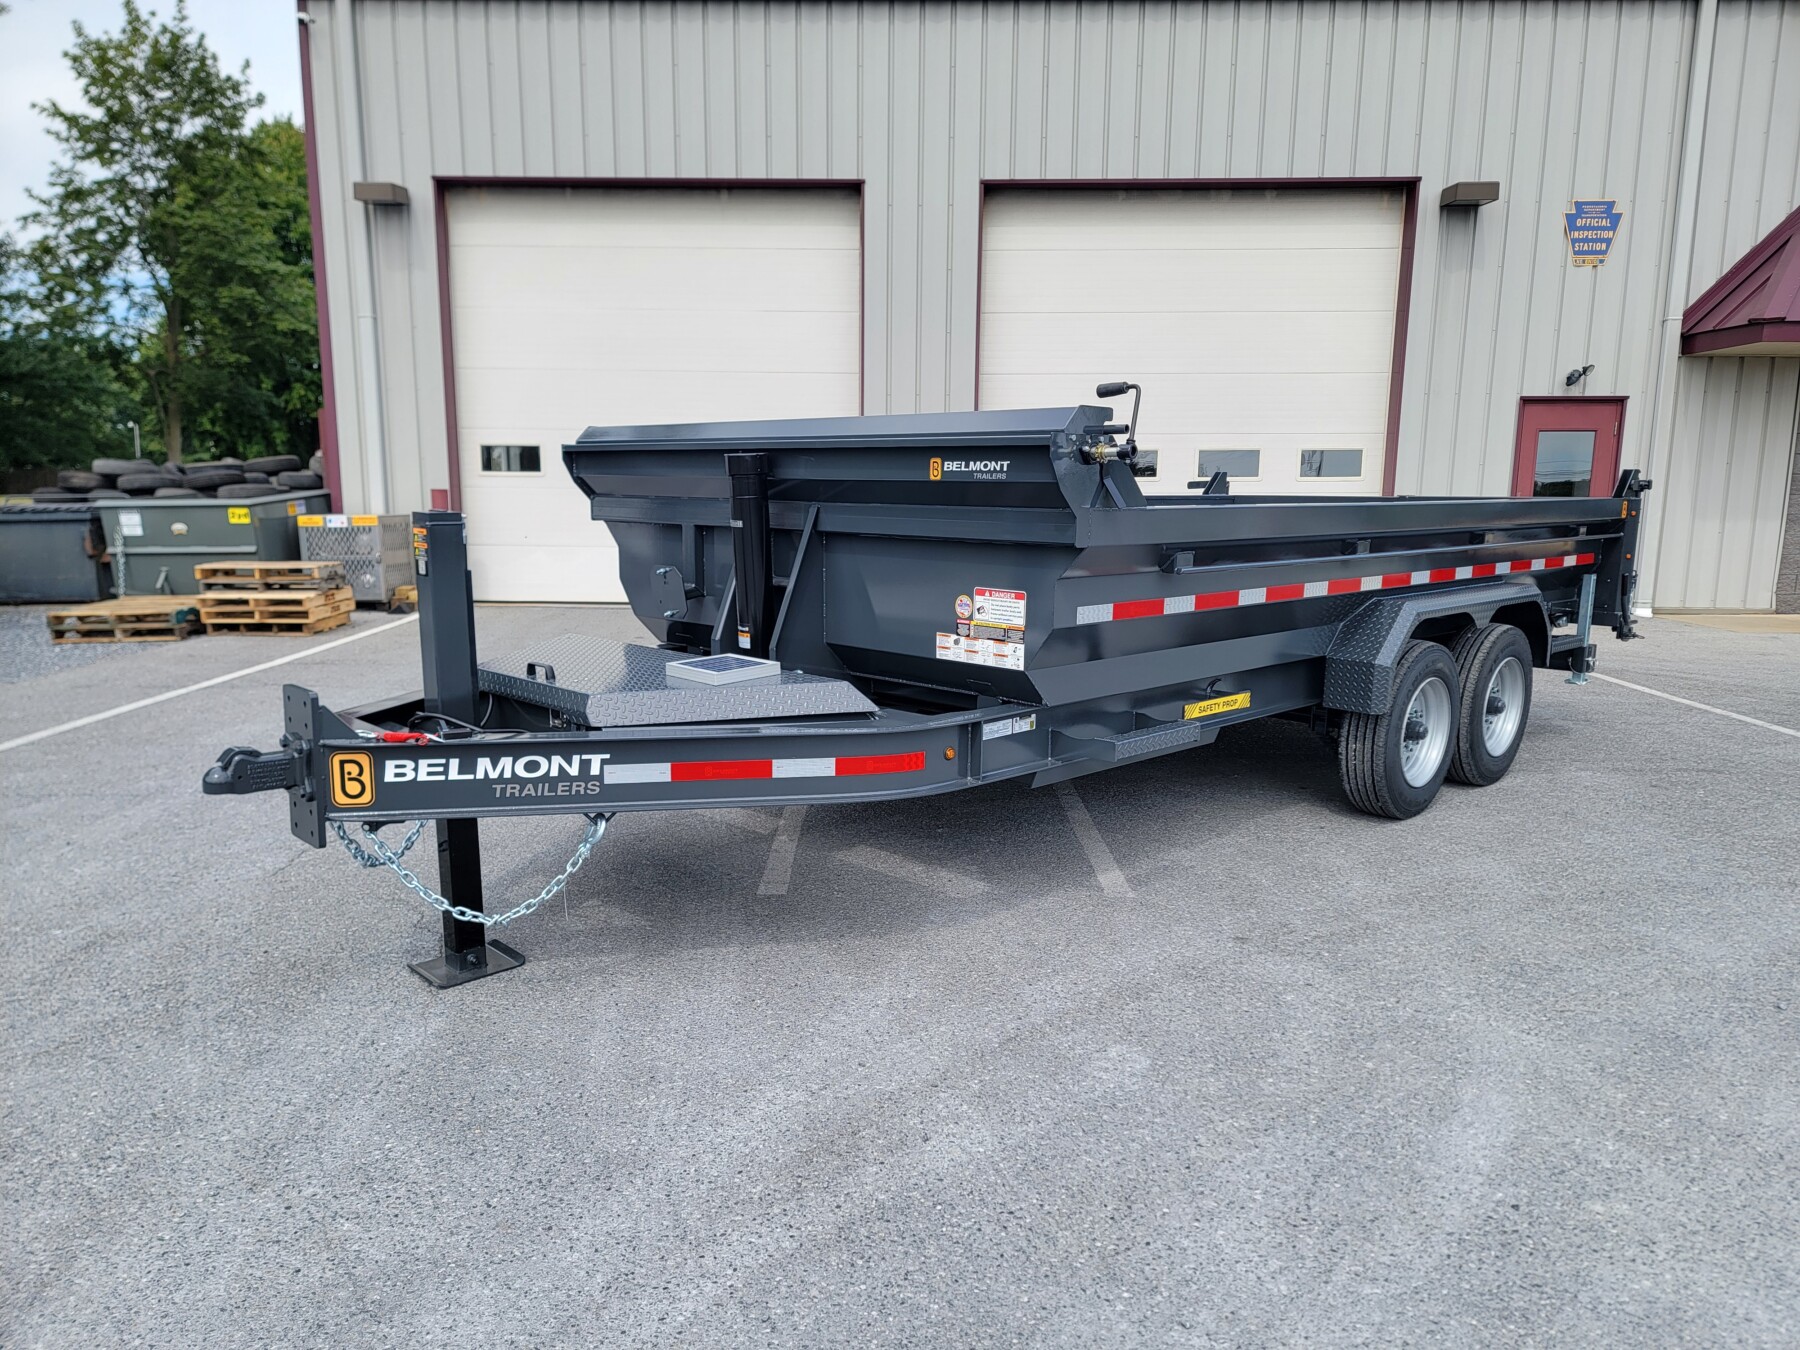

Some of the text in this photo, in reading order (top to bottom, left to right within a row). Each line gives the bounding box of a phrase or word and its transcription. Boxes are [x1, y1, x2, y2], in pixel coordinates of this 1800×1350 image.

[1576, 218, 1611, 227] OFFICIAL
[1571, 230, 1613, 239] INSPECTION
[1574, 242, 1607, 251] STATION
[943, 460, 1010, 471] BELMONT
[973, 472, 1007, 480] TRAILERS
[991, 591, 1016, 600] DANGER
[1198, 698, 1239, 714] SAFETY PROP
[383, 753, 611, 783] BELMONT
[492, 780, 601, 798] TRAILERS
